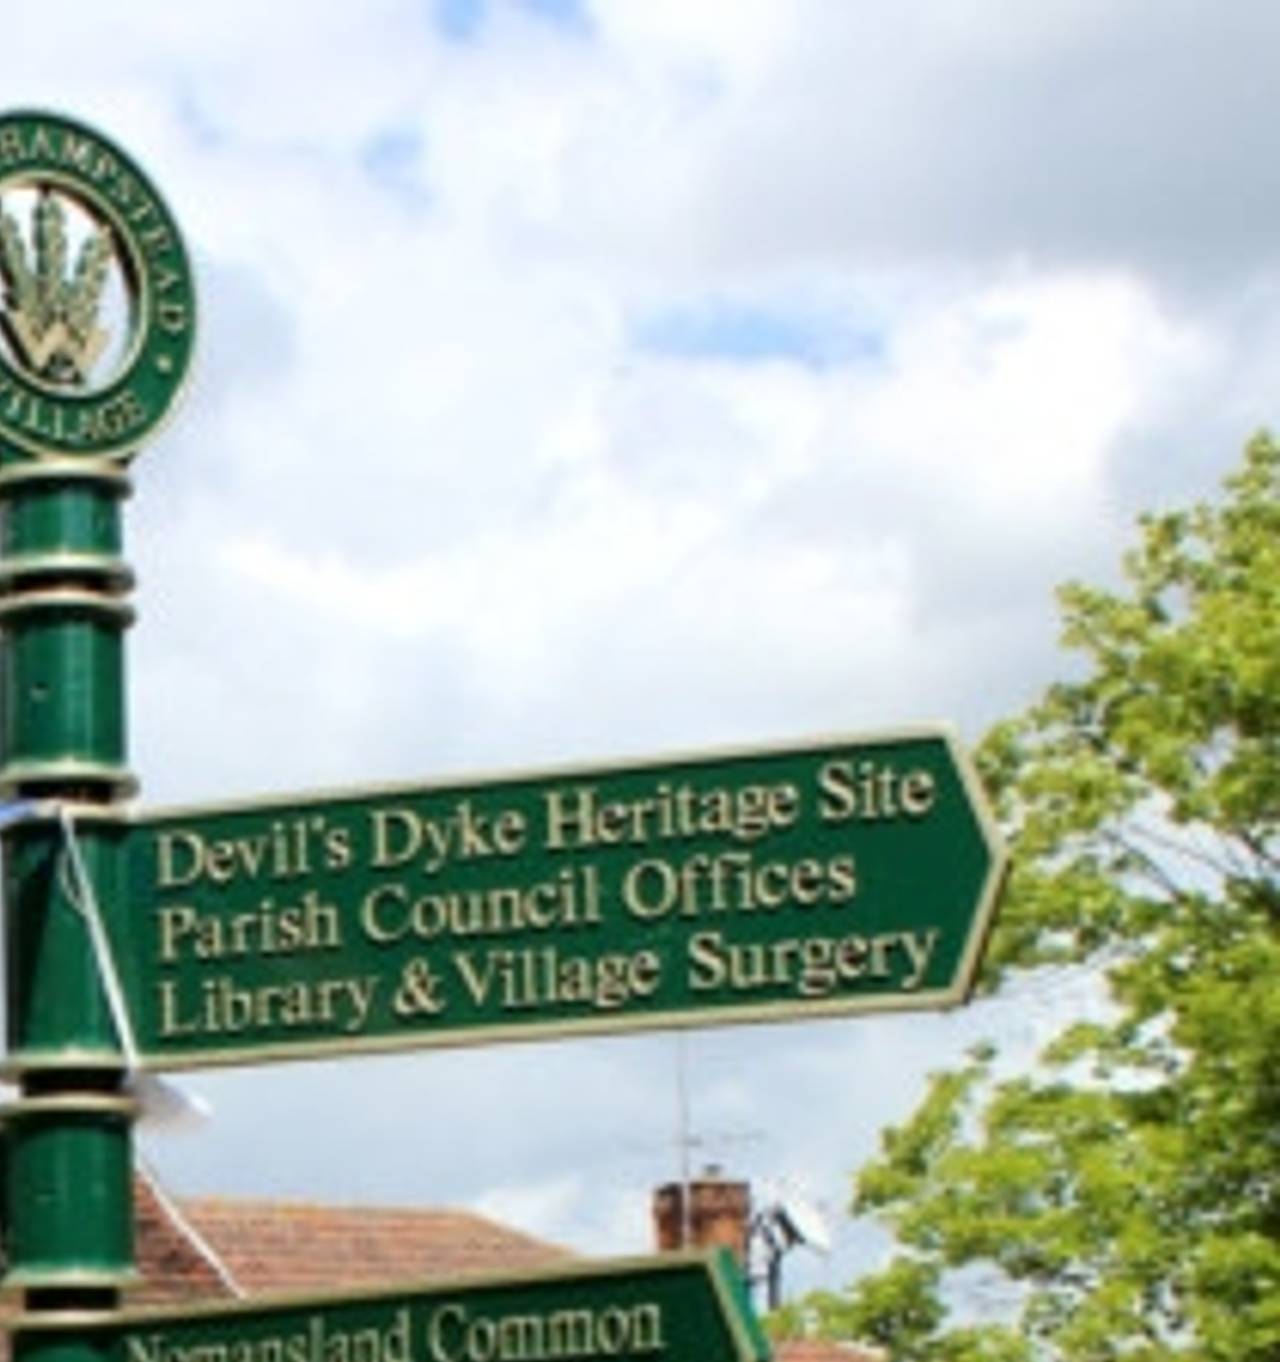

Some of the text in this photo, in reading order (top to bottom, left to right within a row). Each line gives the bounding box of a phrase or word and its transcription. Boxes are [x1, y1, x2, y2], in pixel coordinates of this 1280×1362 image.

[156, 761, 935, 887] Devil's Dyke Heritage Site
[157, 855, 857, 962] Parish Council Offices
[157, 928, 940, 1036] Library & Village Surgery
